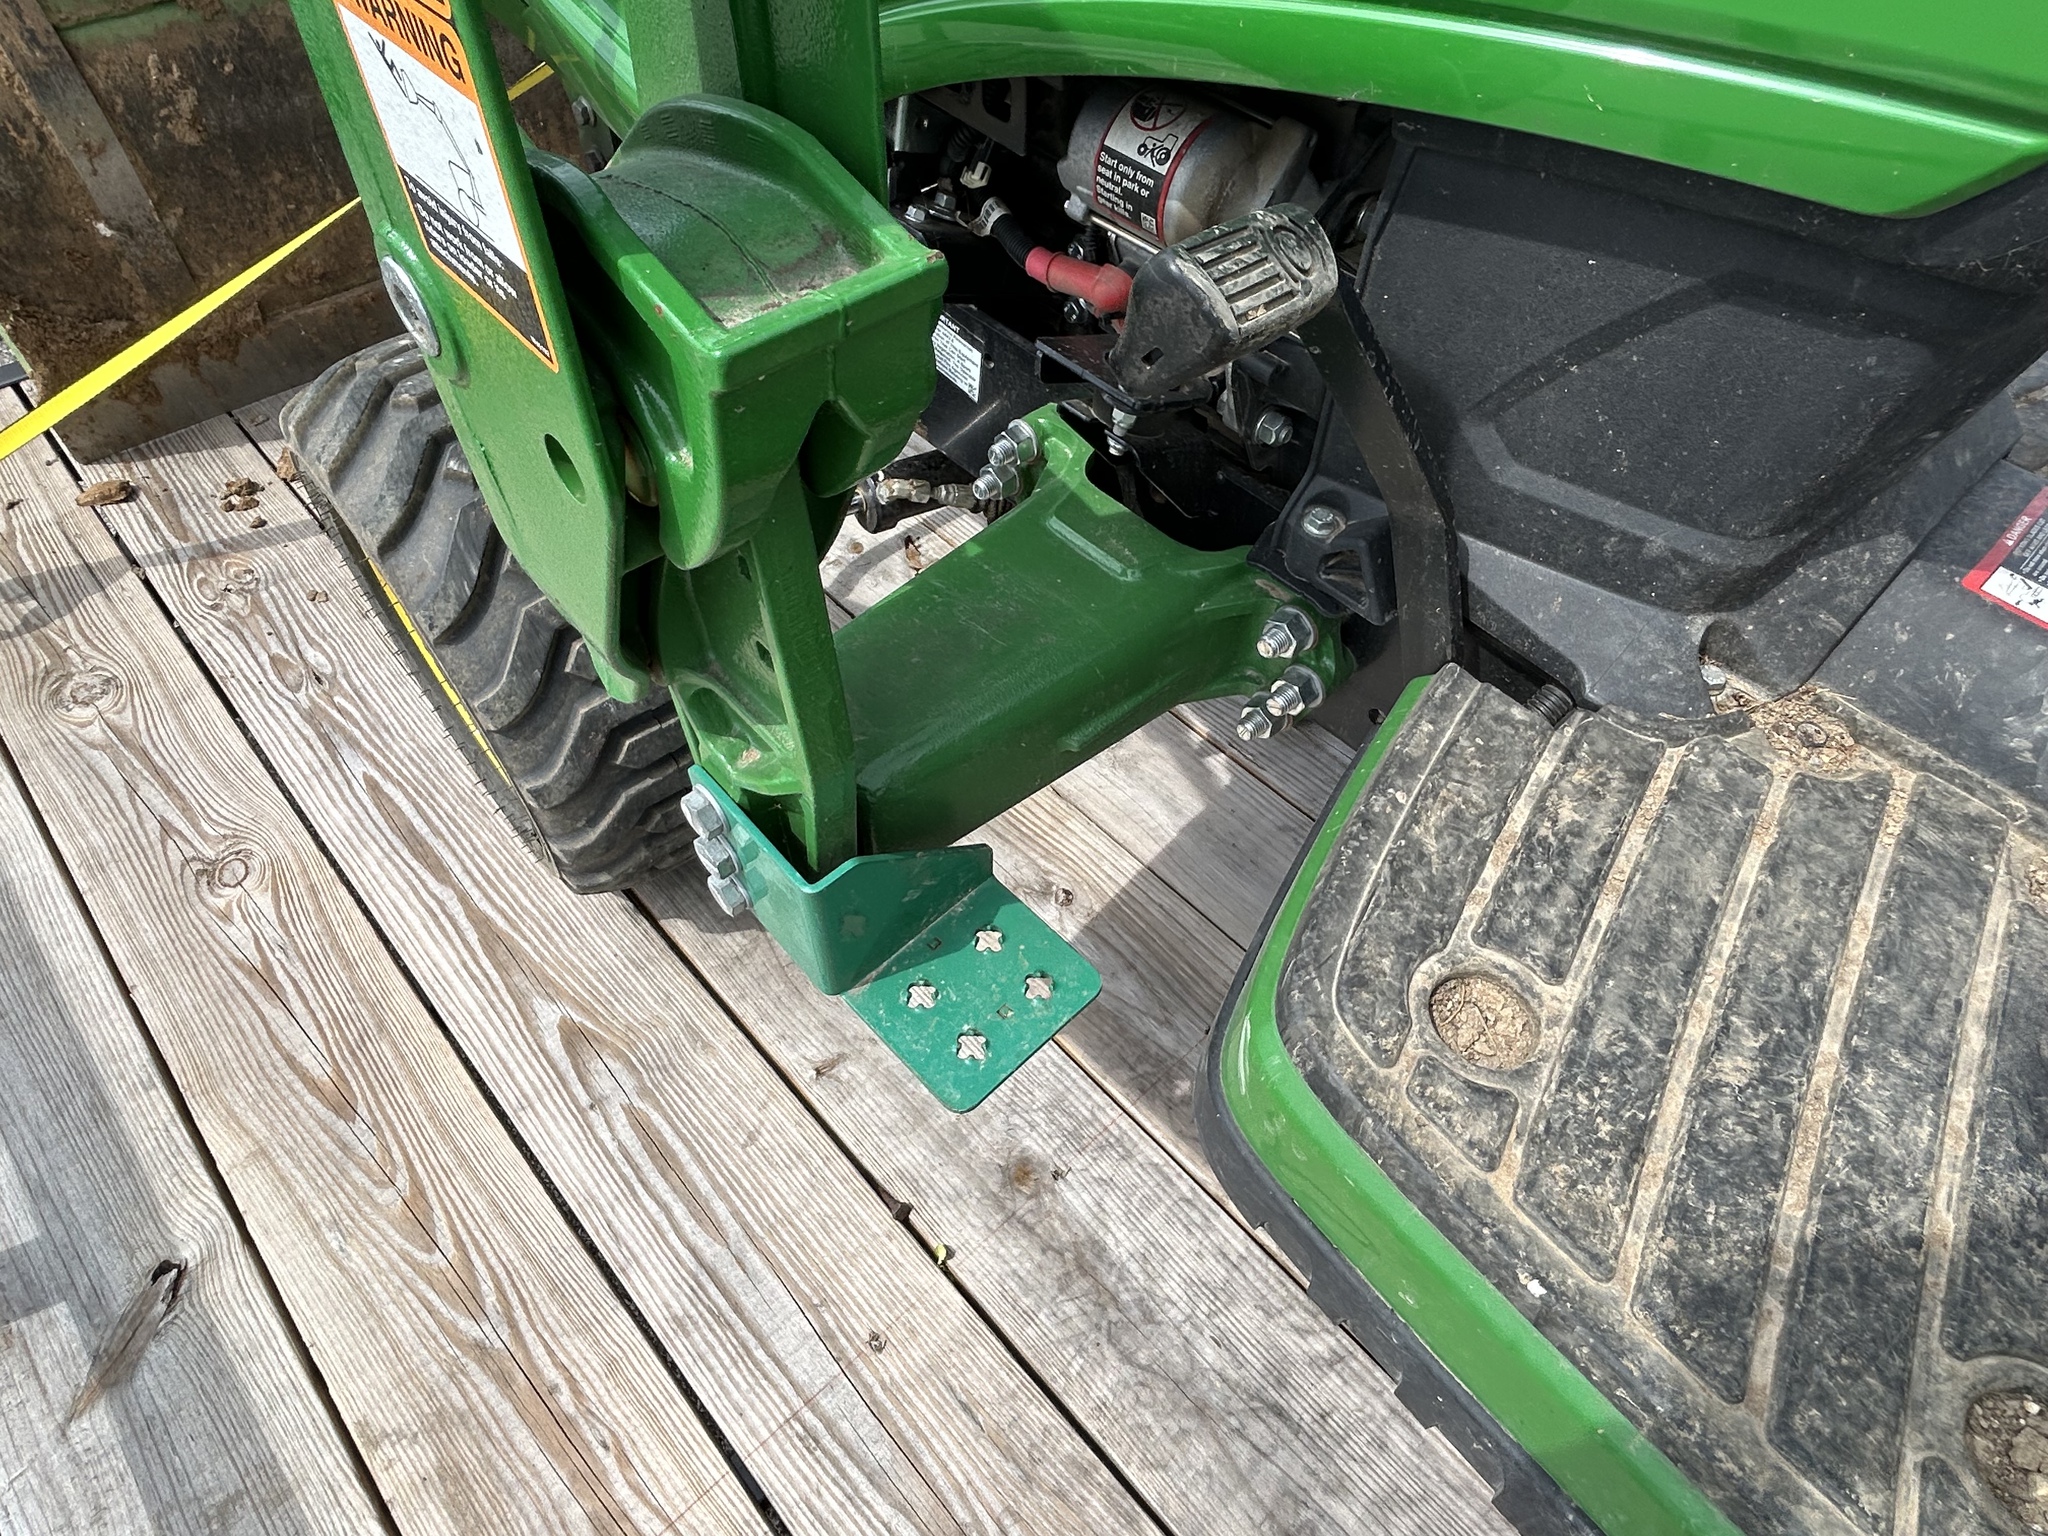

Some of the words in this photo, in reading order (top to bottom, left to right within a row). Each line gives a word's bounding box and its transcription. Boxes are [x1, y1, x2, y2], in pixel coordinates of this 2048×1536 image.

[353, 0, 466, 84] ARNING
[1098, 165, 1112, 179] seat
[1114, 172, 1121, 183] in
[1122, 178, 1139, 193] park
[1140, 188, 1149, 197] or
[1099, 152, 1117, 168] Start
[1118, 163, 1135, 179] only
[1136, 171, 1154, 188] from
[1096, 176, 1122, 196] neutral.
[1096, 185, 1124, 208] Starting
[1126, 201, 1132, 211] in
[2006, 515, 2032, 540] DANGER
